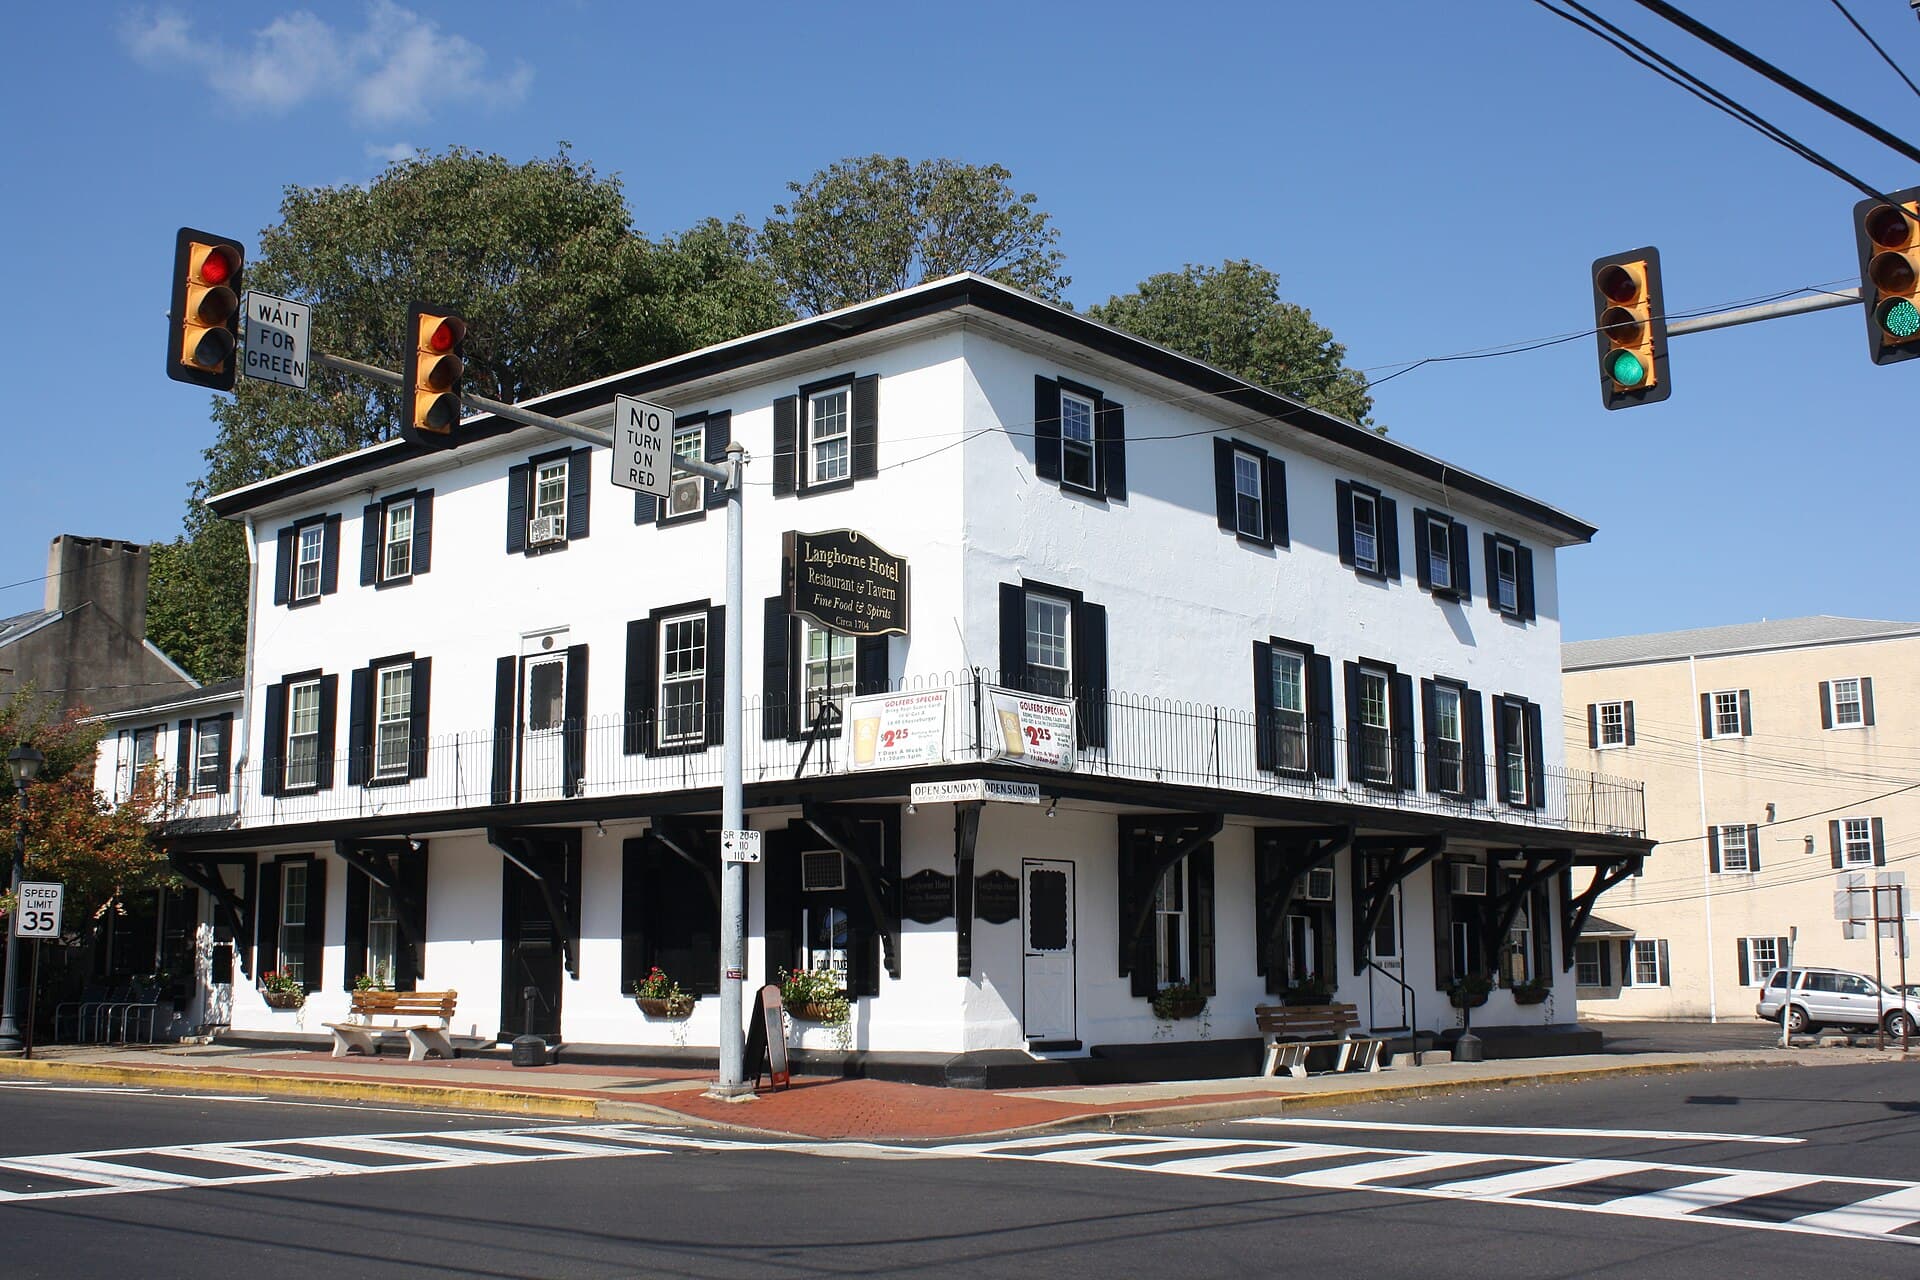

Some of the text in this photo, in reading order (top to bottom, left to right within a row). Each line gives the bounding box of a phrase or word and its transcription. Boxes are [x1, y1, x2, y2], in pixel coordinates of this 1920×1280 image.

[259, 304, 300, 328] WAIT
[261, 329, 294, 352] FOR
[247, 350, 304, 378] GREEN
[630, 407, 660, 432] NO
[627, 430, 661, 452] TURN
[633, 451, 653, 468] ON
[629, 468, 655, 486] RED
[804, 542, 899, 583] Langhorne Hotel
[808, 567, 896, 601] Restaurant & Tavern
[813, 593, 892, 620] Fine Food & Spirits
[835, 616, 870, 631] Circa 1704
[885, 694, 943, 708] GOLFERS SPECIAL
[1020, 701, 1044, 714] GOLFERS
[1045, 705, 1068, 717] SPECIAL
[914, 786, 940, 796] OPEN
[941, 782, 978, 794] SUNDAY
[984, 782, 1038, 796] OPEN SUNDAY
[723, 831, 758, 840] SR 2049
[739, 841, 749, 850] 110
[734, 851, 745, 860] 110
[24, 888, 58, 898] SPEED
[27, 900, 53, 909] LIMIT
[23, 911, 54, 931] 35
